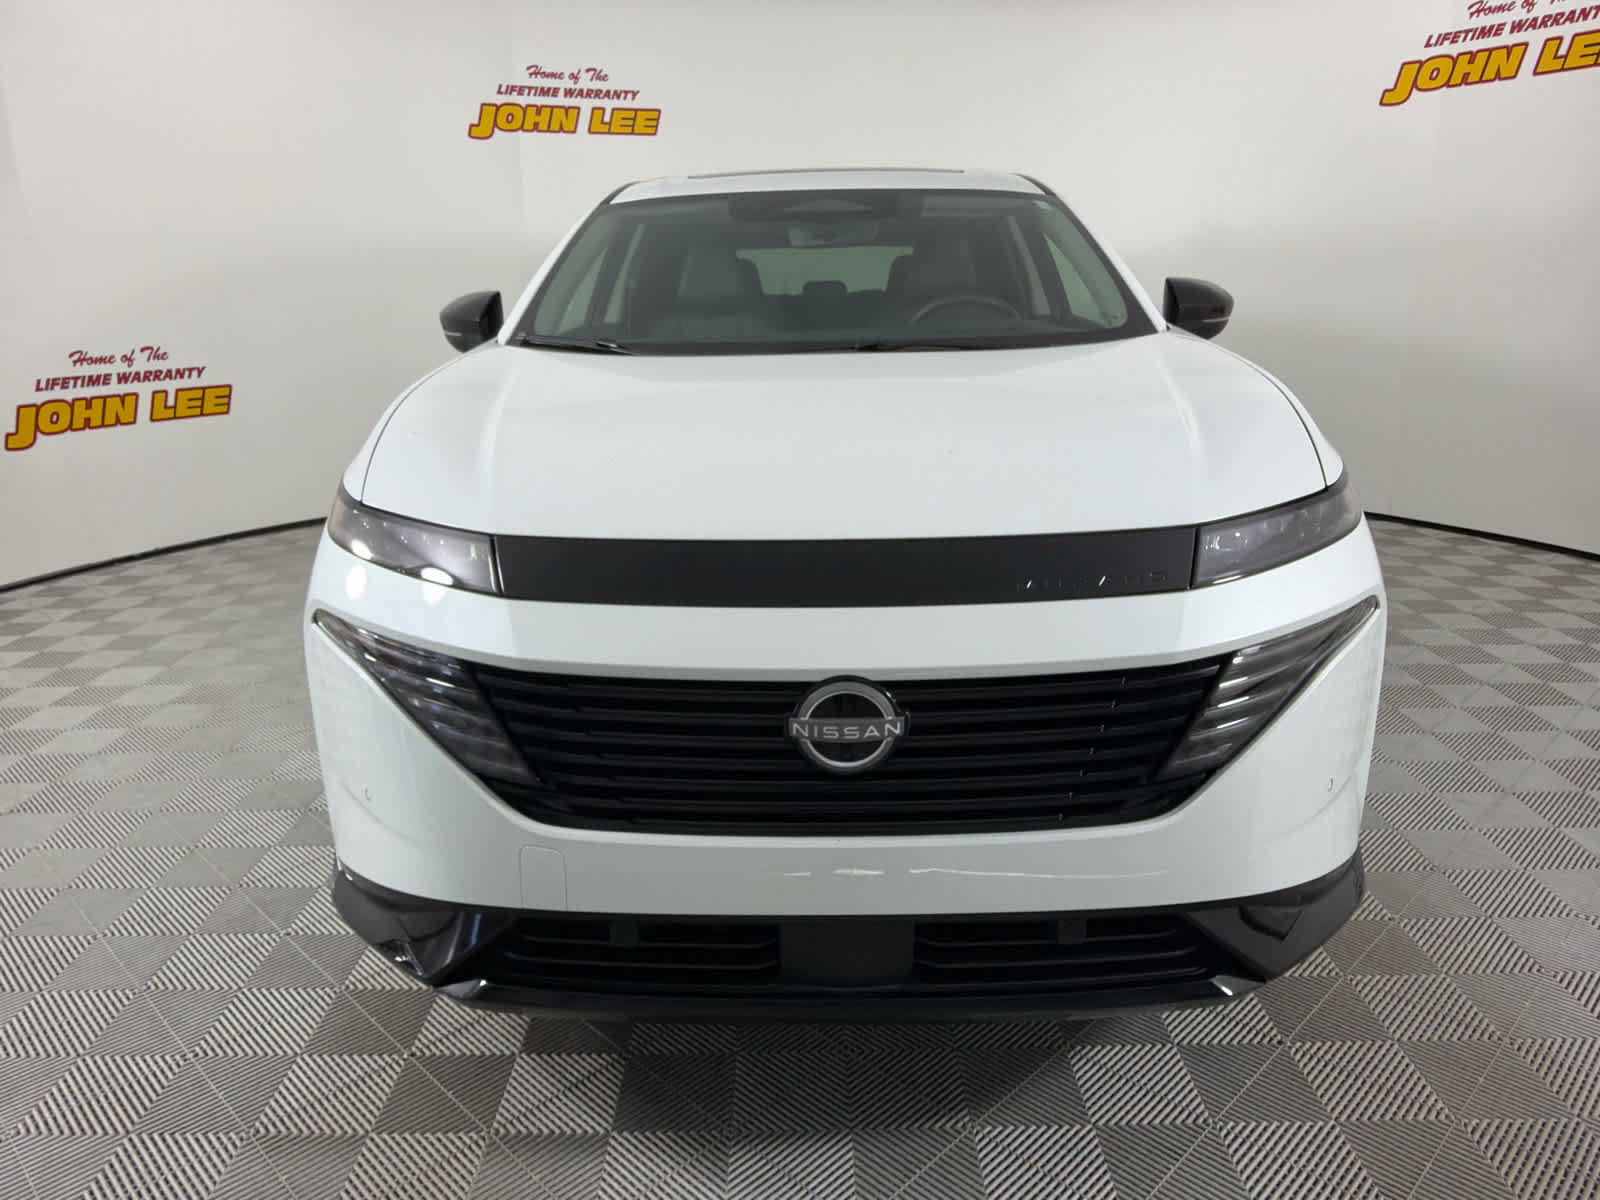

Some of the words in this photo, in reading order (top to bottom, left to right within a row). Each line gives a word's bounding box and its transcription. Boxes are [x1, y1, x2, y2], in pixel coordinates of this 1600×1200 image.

[1467, 0, 1516, 20] Home
[1424, 22, 1507, 48] LIFETIME
[526, 64, 565, 81] Home
[568, 69, 582, 85] of
[585, 67, 609, 82] The
[1379, 41, 1529, 107] JOHN
[1532, 28, 1600, 76] LE
[497, 84, 560, 98] LIFETIME
[563, 87, 640, 101] WARRANTY
[468, 102, 580, 140] JOHN
[588, 107, 661, 136] LEE
[68, 350, 117, 367] Home
[120, 349, 136, 368] of
[140, 345, 169, 362] The
[34, 373, 112, 392] LIFETIME
[116, 366, 207, 385] WARRANTY
[4, 392, 139, 451] JOHN
[149, 384, 233, 423] LEE
[792, 721, 901, 740] NISSAN
